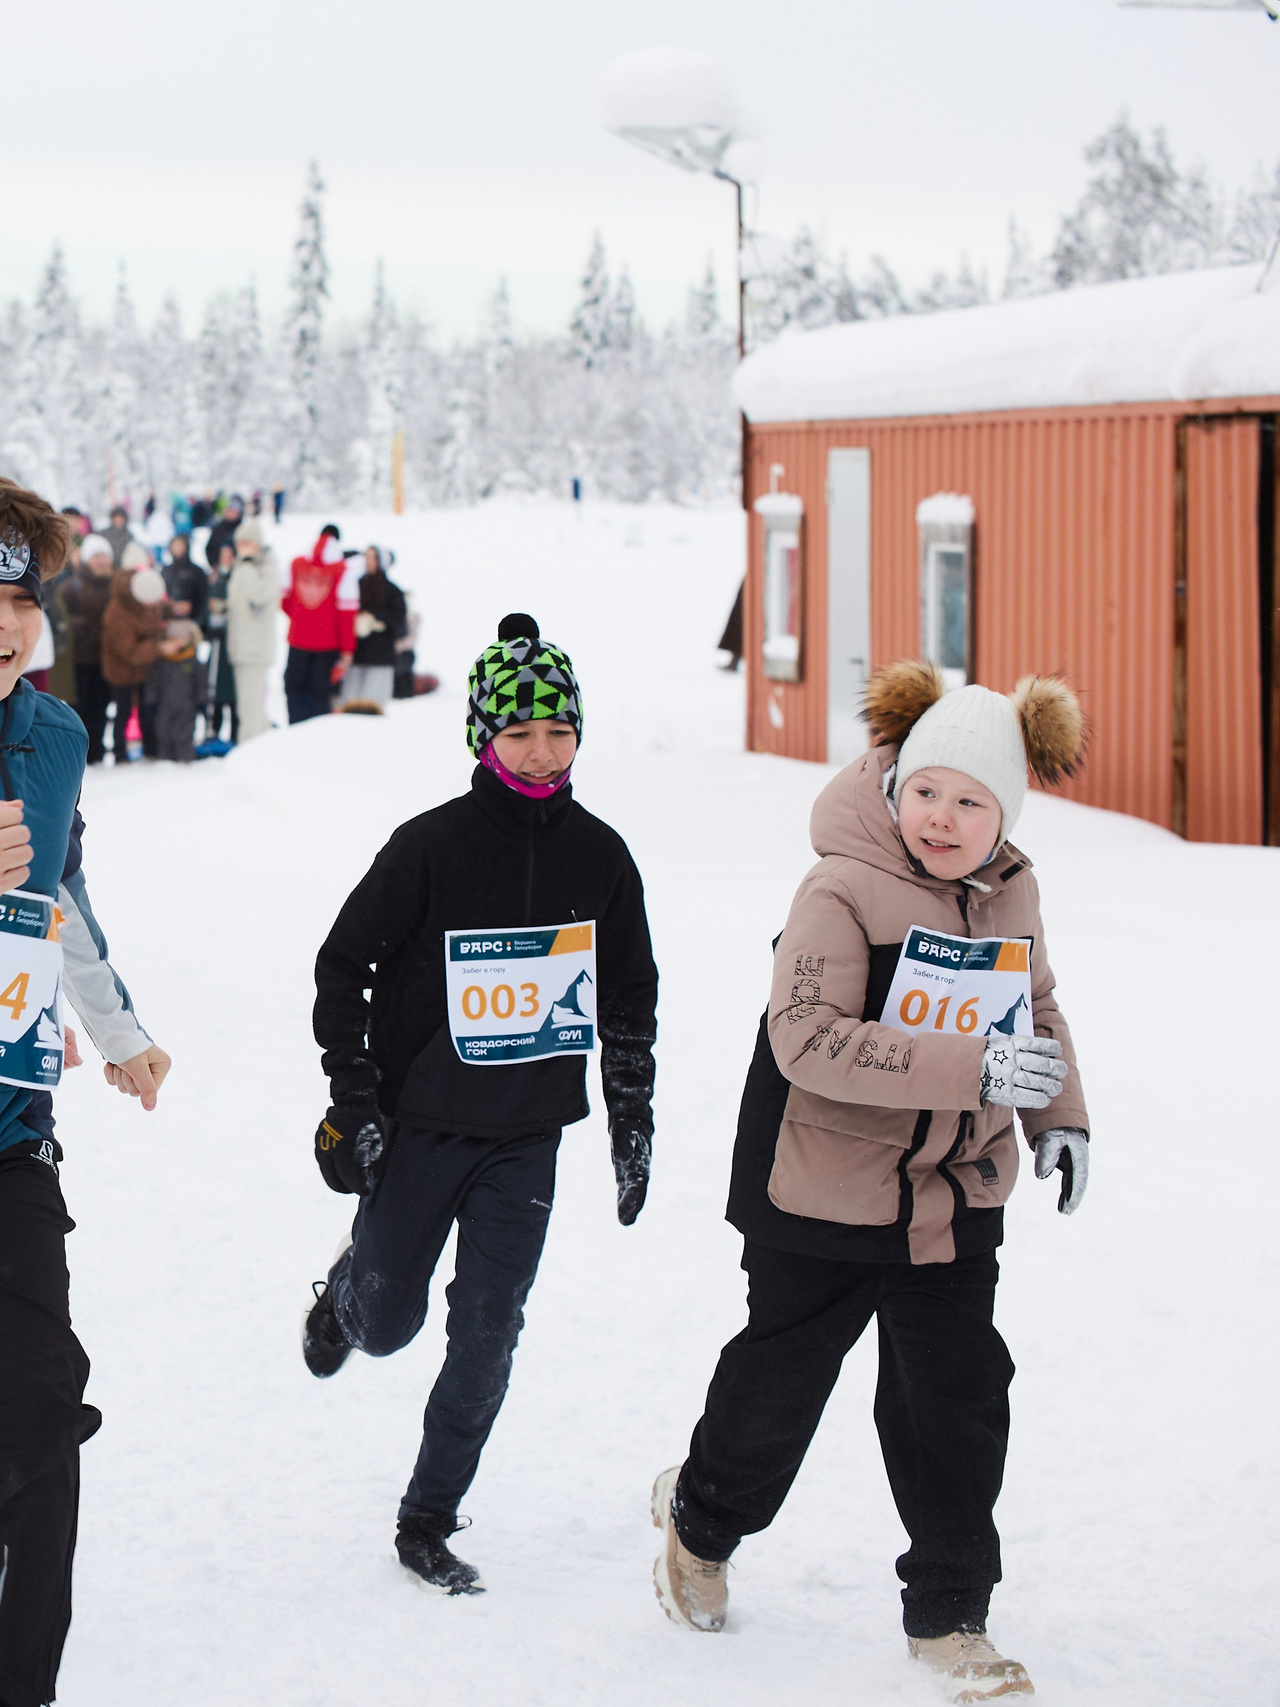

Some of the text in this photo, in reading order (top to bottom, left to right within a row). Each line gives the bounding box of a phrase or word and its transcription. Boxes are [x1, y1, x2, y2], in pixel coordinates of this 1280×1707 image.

[489, 966, 506, 975] гору
[912, 967, 934, 980] Забег
[461, 982, 540, 1020] 003
[899, 989, 981, 1034] 016
[465, 1036, 536, 1049] КОВДОРСКИЙ
